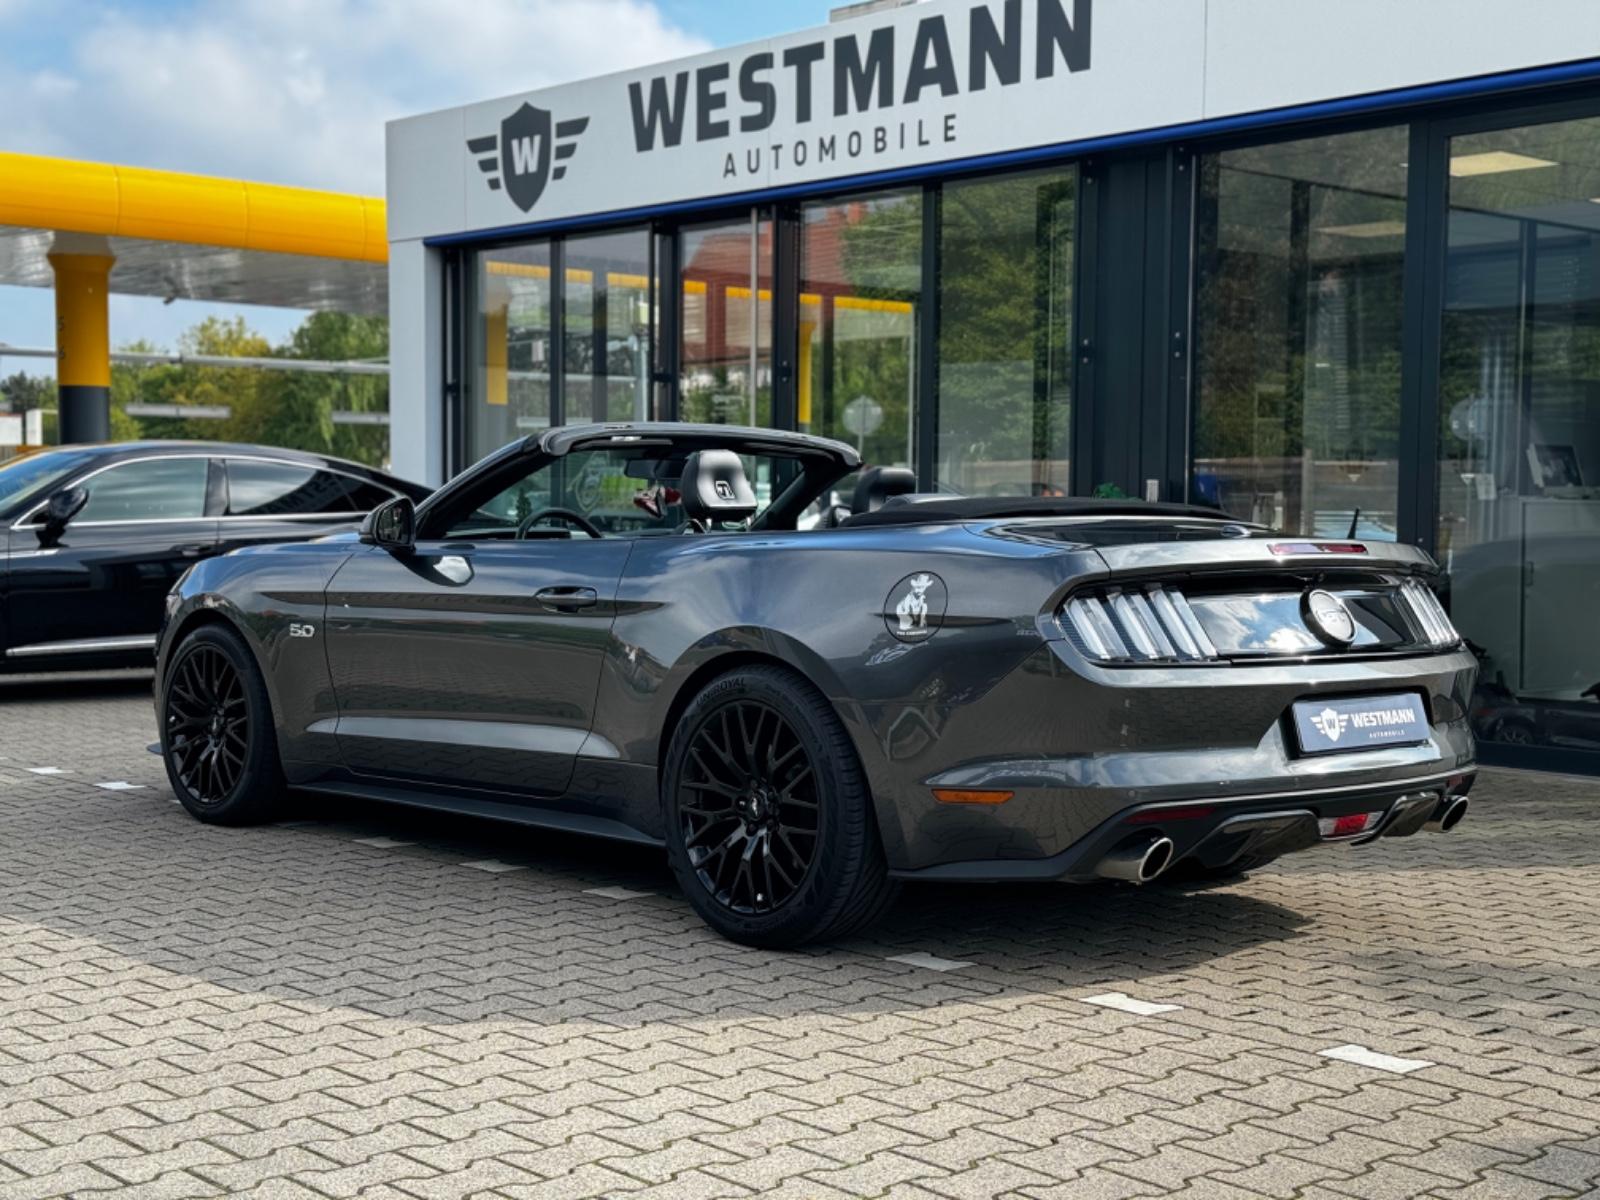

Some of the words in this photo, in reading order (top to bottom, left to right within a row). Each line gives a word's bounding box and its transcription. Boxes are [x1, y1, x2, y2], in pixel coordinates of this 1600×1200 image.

[628, 0, 1092, 152] WESTMANN
[511, 135, 541, 175] W
[722, 113, 958, 179] AUTOMOBILE
[1350, 708, 1415, 728] WESTMANN
